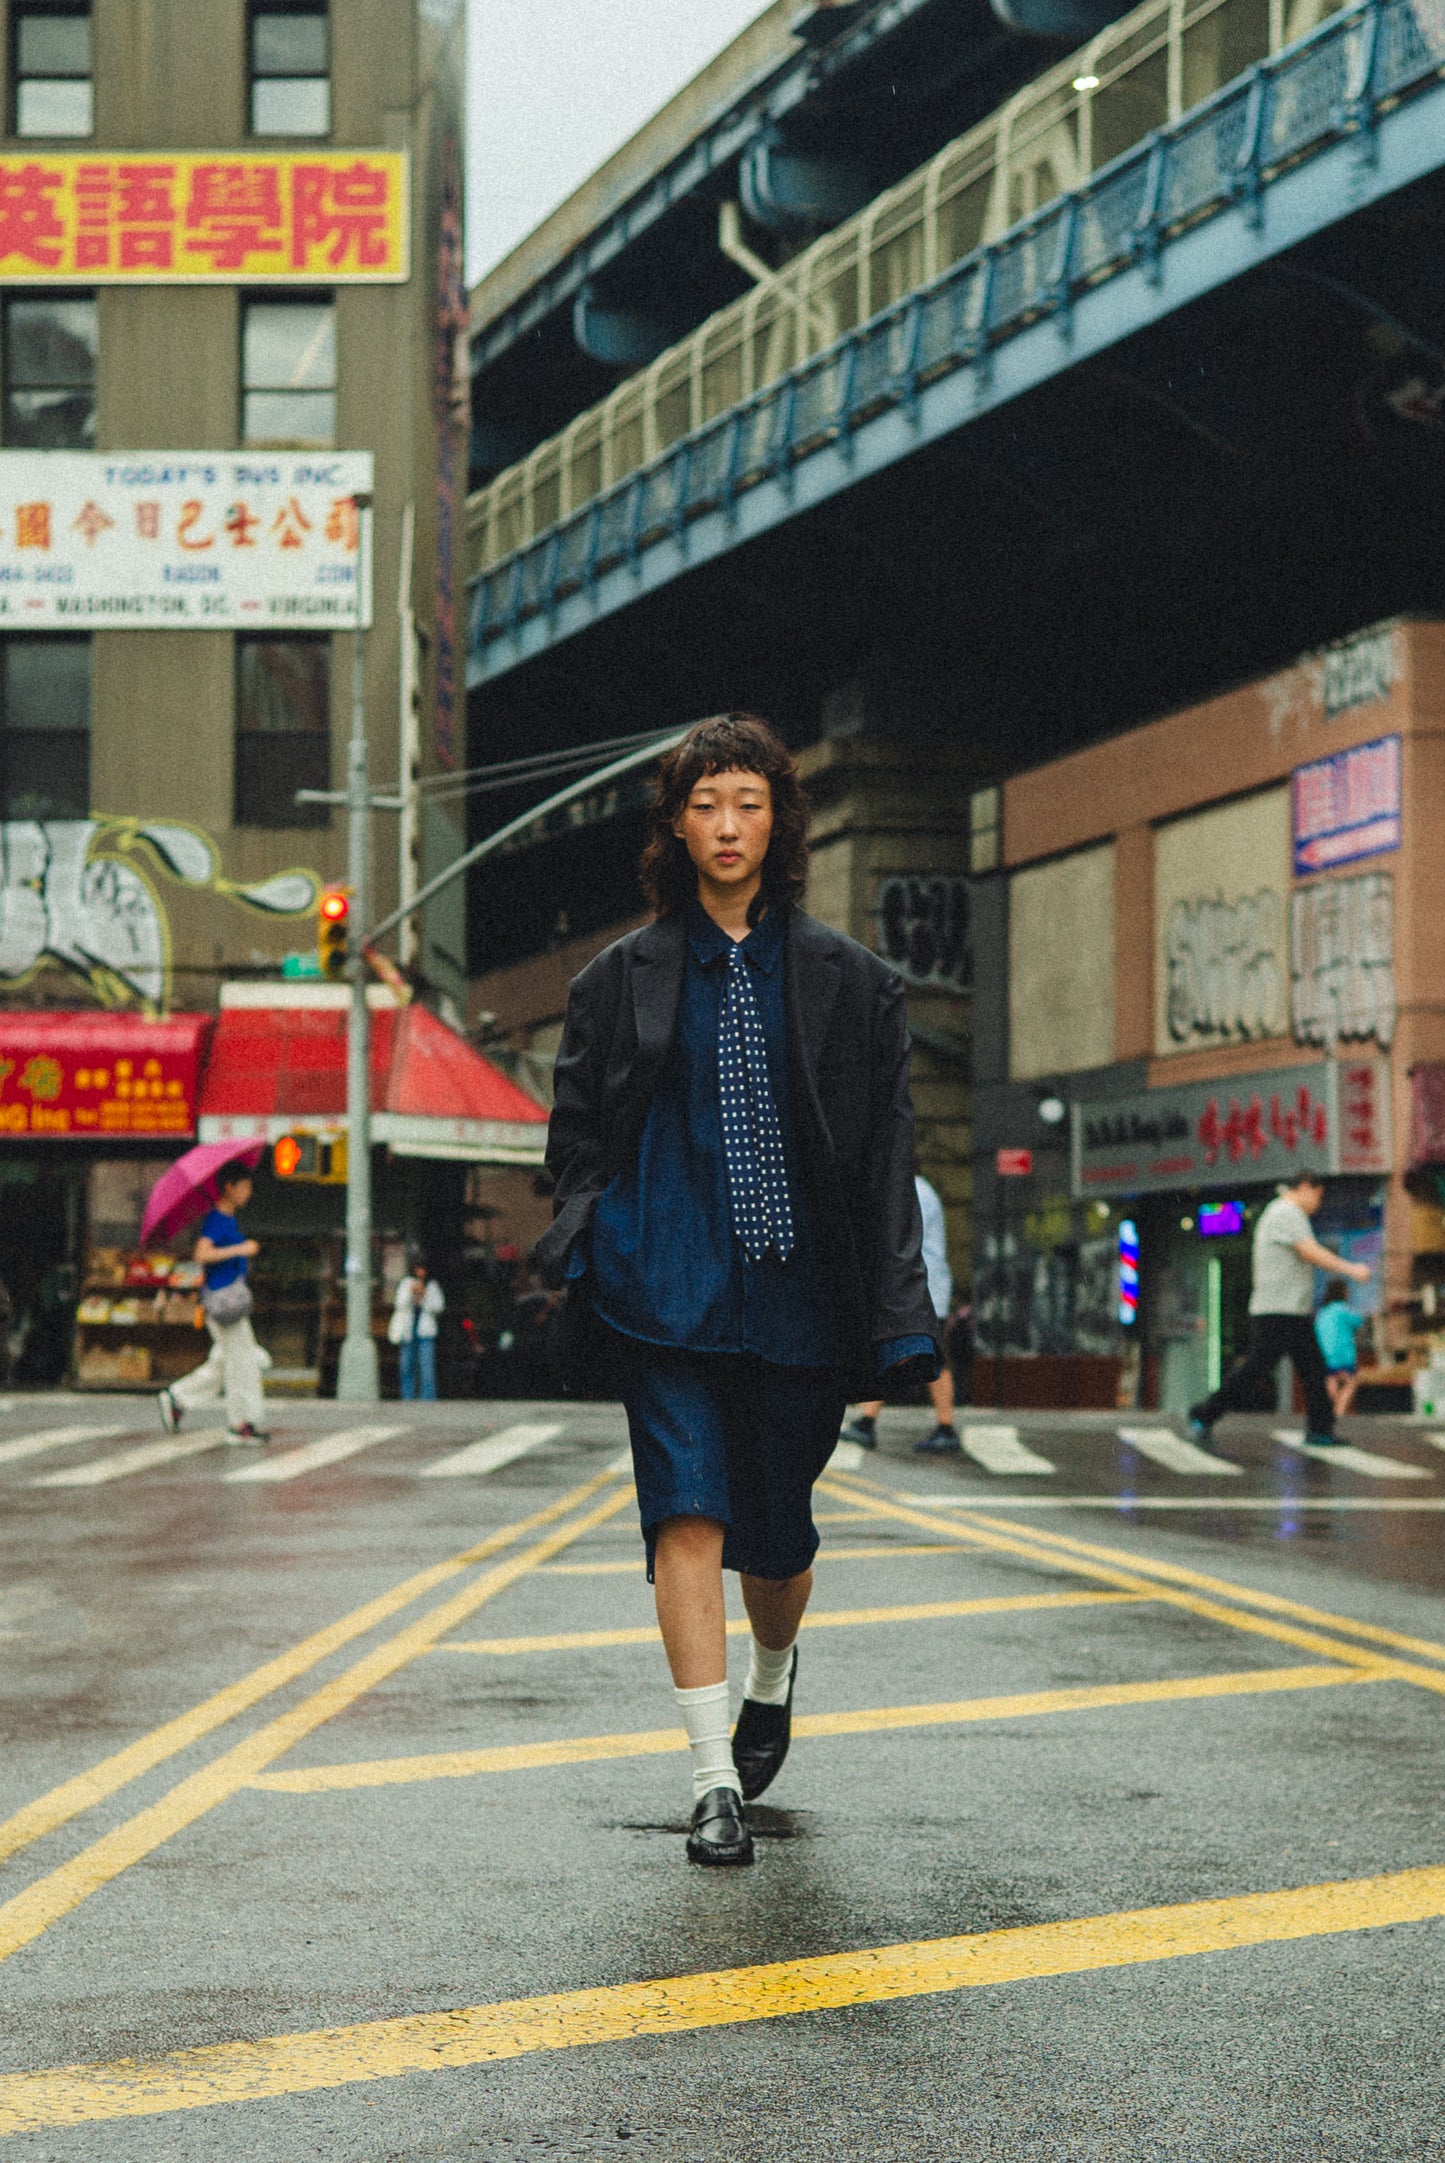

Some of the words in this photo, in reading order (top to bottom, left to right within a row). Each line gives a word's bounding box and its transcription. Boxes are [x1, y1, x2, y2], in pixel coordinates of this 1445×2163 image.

[0, 162, 389, 269] 英語學院
[105, 467, 216, 485] TODAY'S
